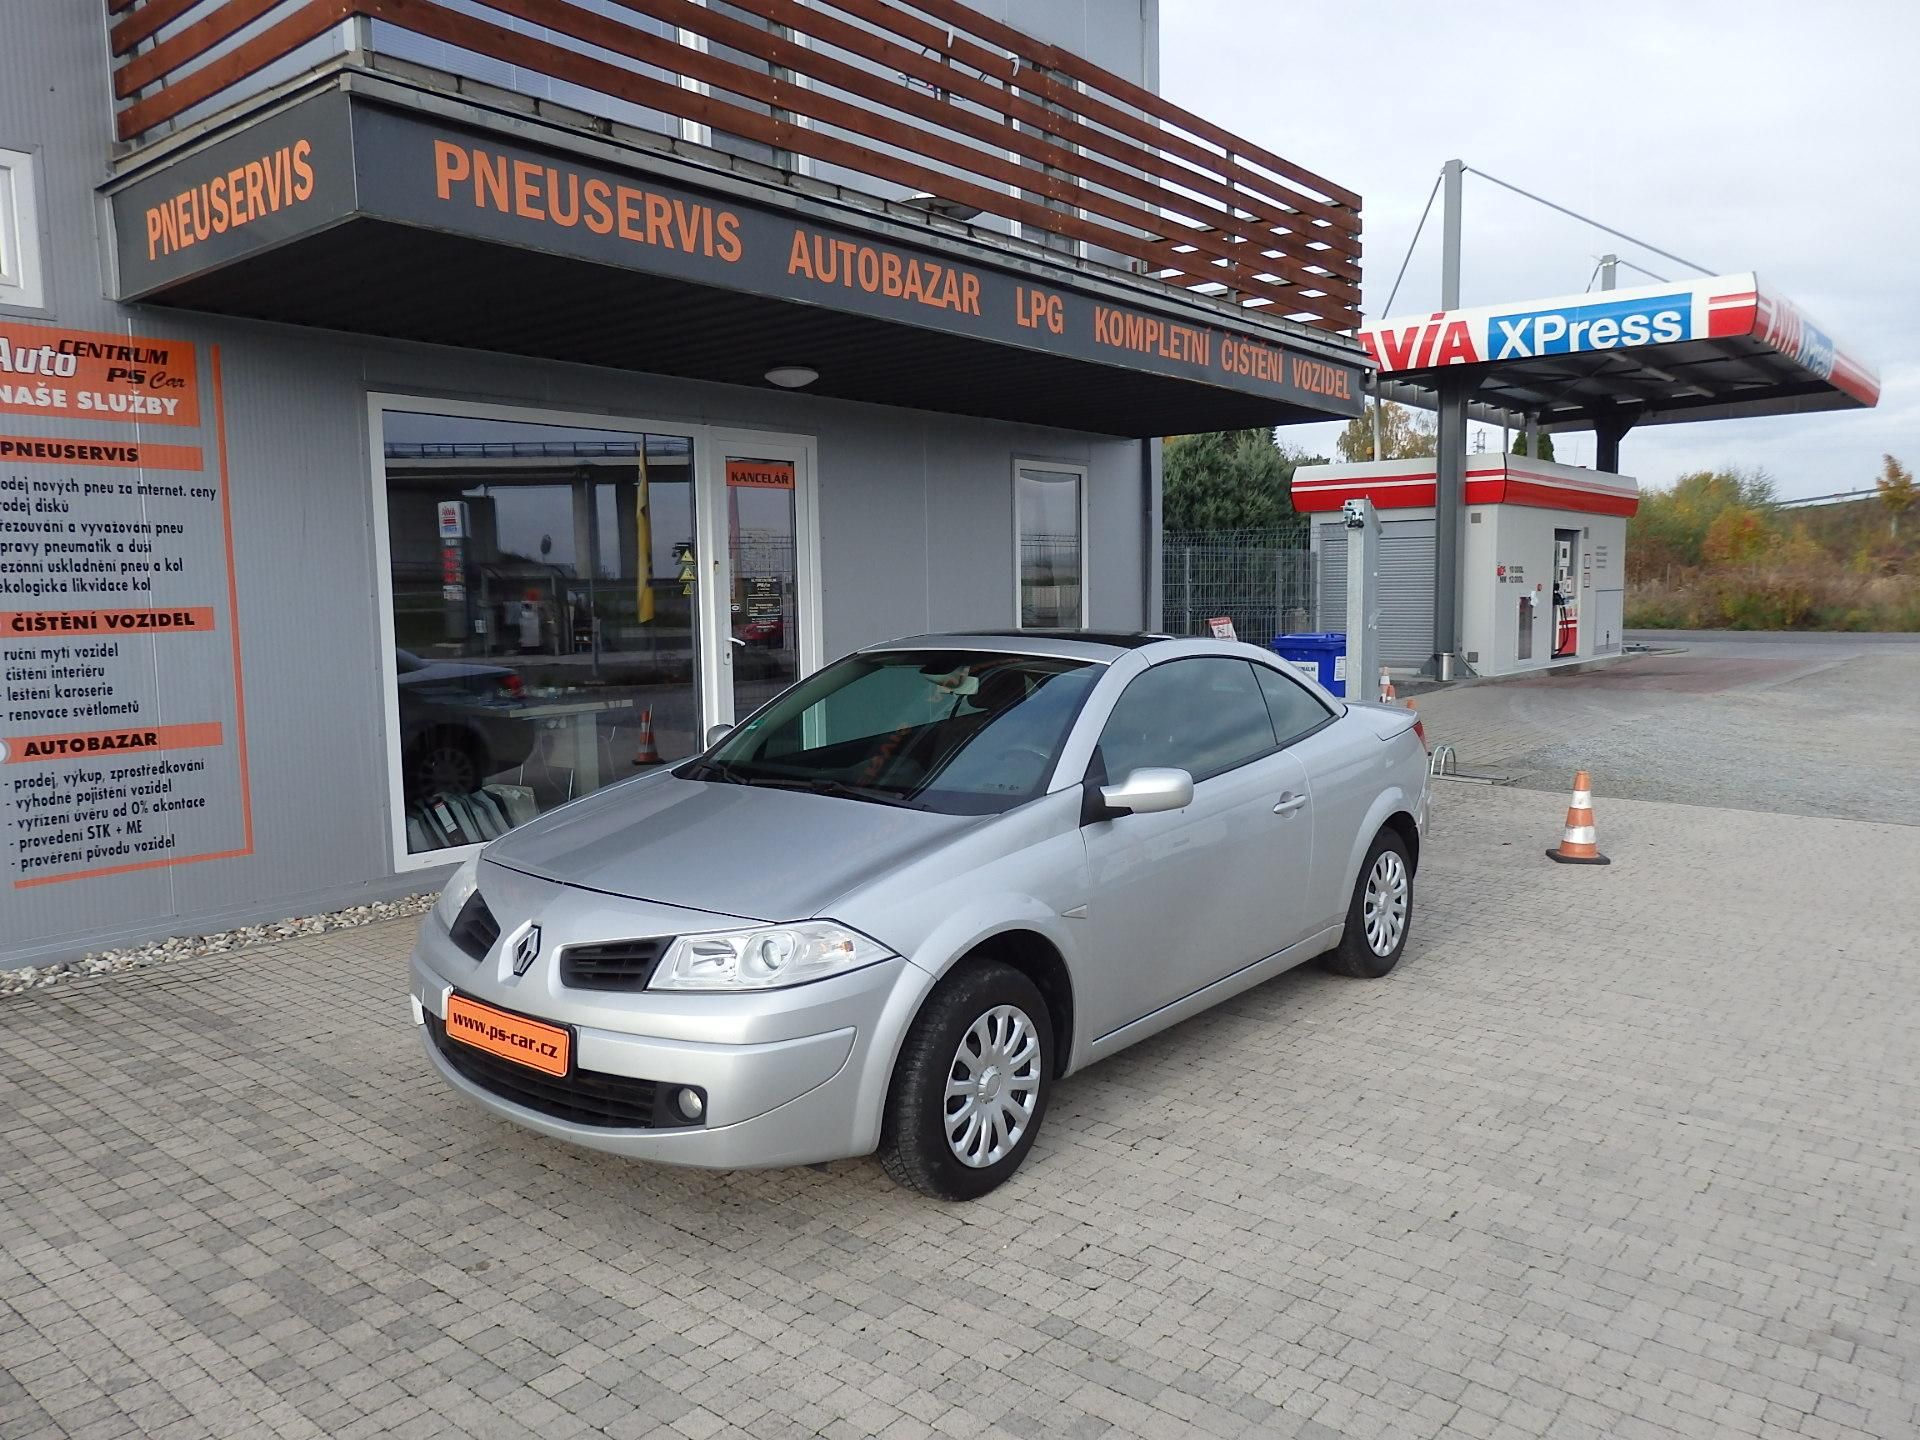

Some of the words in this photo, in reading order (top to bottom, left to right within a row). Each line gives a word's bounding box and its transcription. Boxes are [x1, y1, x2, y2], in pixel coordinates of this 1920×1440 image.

[146, 139, 315, 261] PNEUSERVIS
[434, 139, 743, 263] PNEUSERVIS
[787, 229, 981, 317] AUTOBAZAR
[1016, 286, 1064, 335] LPG
[1094, 305, 1213, 367] KOMPLETNÍ
[1220, 330, 1285, 385] ČIŠTĚNÍ
[1292, 357, 1351, 400] VOZIDEL
[1496, 309, 1683, 360] XPress
[59, 339, 169, 366] CENTRUM
[107, 367, 148, 385] PS
[149, 371, 187, 390] Car
[0, 381, 68, 408] NAŠE
[77, 389, 180, 416] SLUŽBY
[0, 441, 139, 462] PNEUSERVIS
[0, 476, 29, 495] odej
[33, 477, 80, 496] nových
[84, 483, 115, 497] pneu
[118, 484, 133, 495] za
[190, 487, 217, 501] ceny
[731, 471, 789, 485] KANCELÁŘ
[0, 497, 31, 516] odej
[68, 523, 77, 533] a
[155, 523, 184, 537] pneu
[0, 542, 39, 557] pravy
[44, 538, 112, 557] pneumatik
[116, 543, 125, 553] a
[0, 559, 44, 573] ezónní
[120, 561, 150, 576] pneu
[153, 562, 161, 572] a
[164, 557, 184, 572] kol
[72, 576, 129, 593] likvidace
[132, 576, 152, 592] kol
[11, 610, 97, 632] ČIŠTĚNÍ
[104, 612, 195, 628] VOZIDEL
[4, 646, 37, 661] ruční
[74, 642, 119, 659] vozidel
[51, 663, 105, 679] interiéru
[54, 682, 114, 700] karoserie
[9, 707, 69, 722] renovace
[24, 733, 158, 757] AUTOBAZAR
[16, 790, 72, 813] výhodné
[131, 778, 173, 797] vozidel
[112, 802, 128, 818] od
[131, 800, 149, 815] 0%
[152, 797, 206, 813] akontace
[87, 823, 111, 840] STK
[134, 833, 176, 853] vozidel
[453, 1012, 558, 1059] www.ps-car.cz
